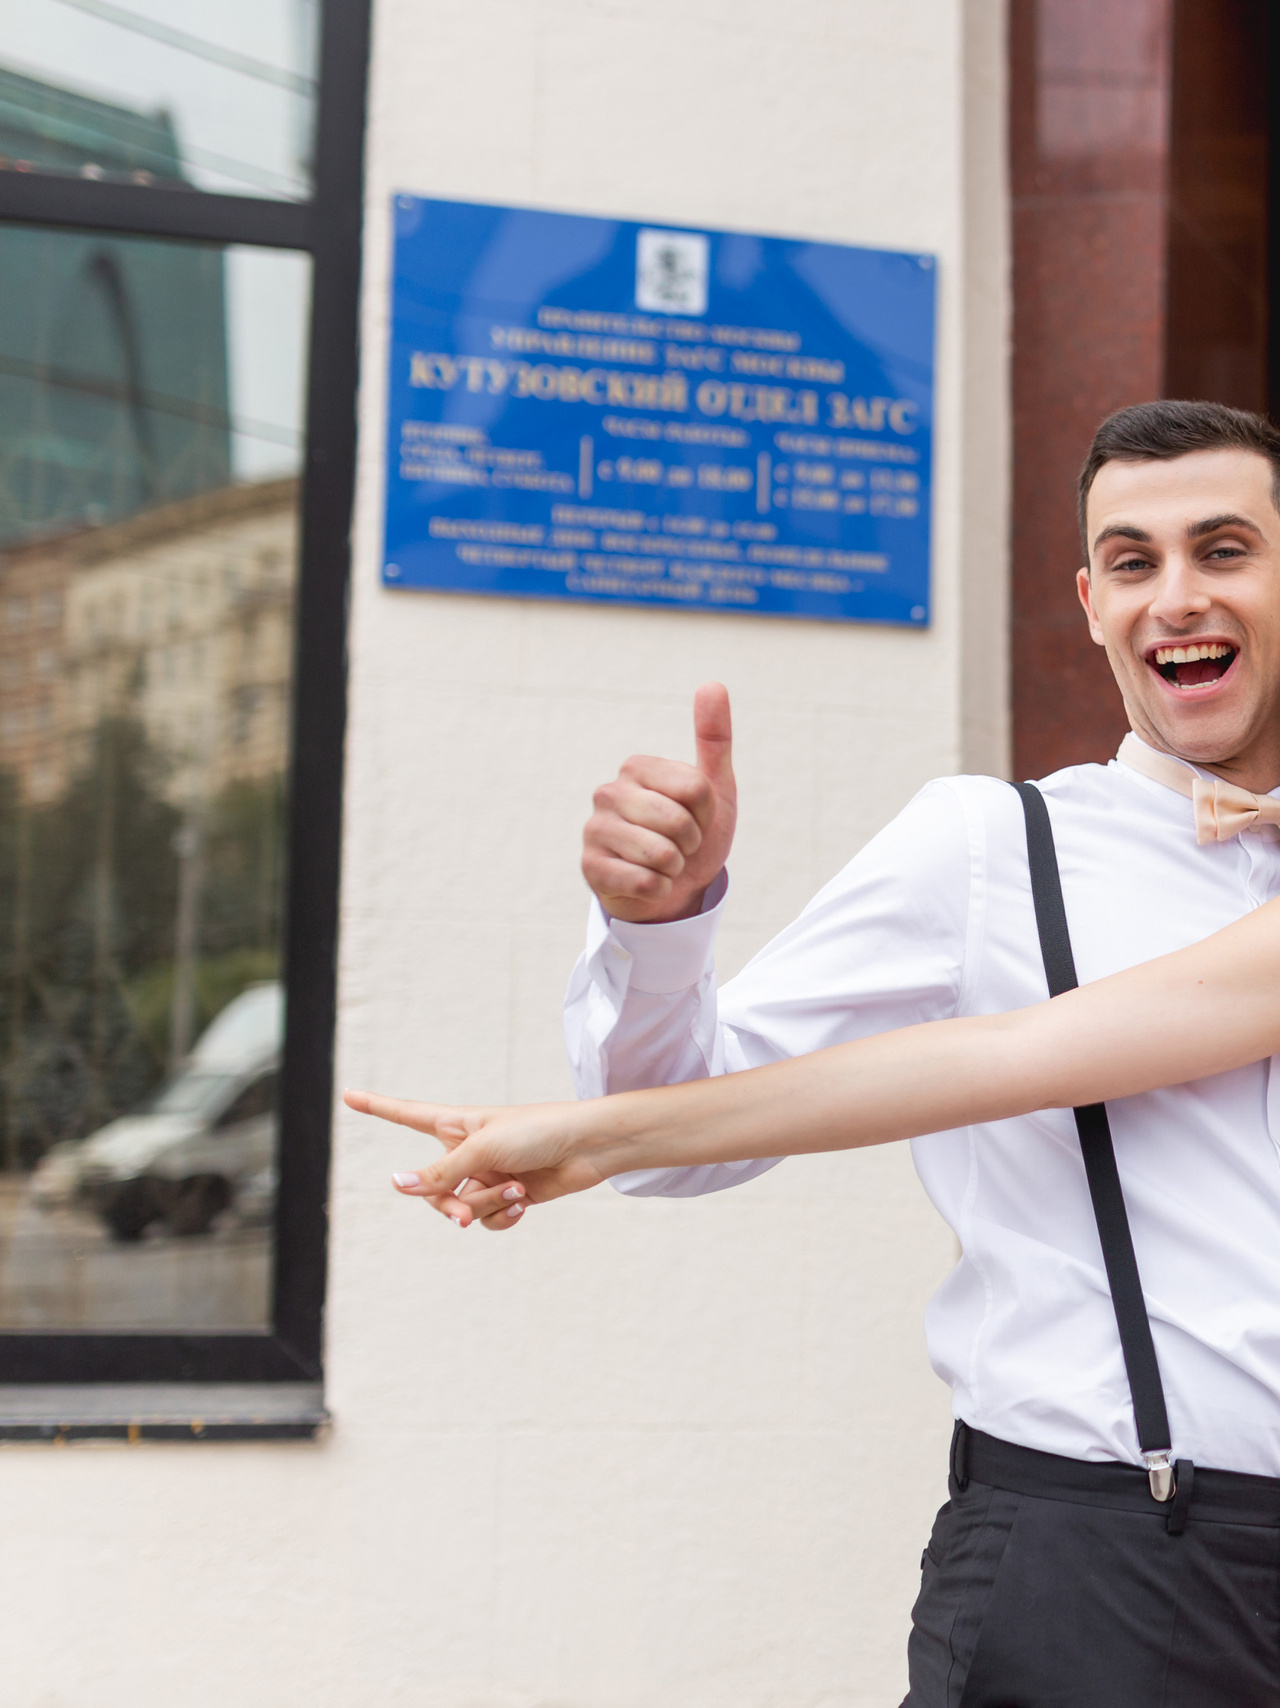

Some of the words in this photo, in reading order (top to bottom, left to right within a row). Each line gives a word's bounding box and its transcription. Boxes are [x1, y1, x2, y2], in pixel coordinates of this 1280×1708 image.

[411, 353, 688, 411] КУТУЗОВСКИЙ
[698, 381, 817, 424] ОТДЕЛ
[827, 393, 918, 434] ЗАГС
